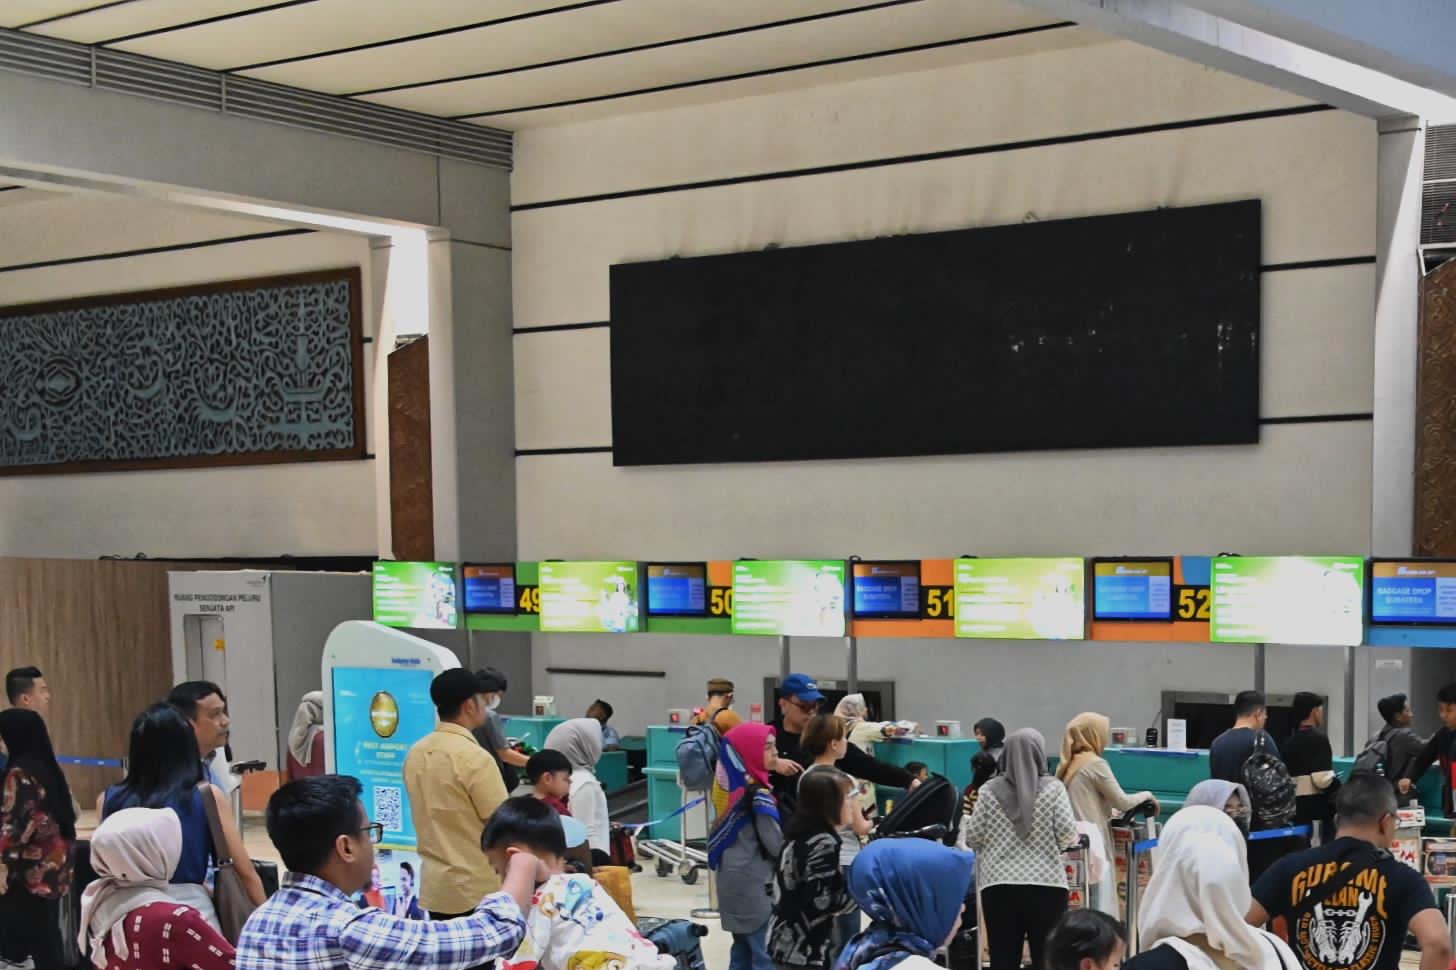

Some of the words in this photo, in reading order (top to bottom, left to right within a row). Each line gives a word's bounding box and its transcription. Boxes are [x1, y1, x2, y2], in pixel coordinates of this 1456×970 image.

[520, 588, 539, 612] 49
[711, 589, 732, 615] 50
[928, 589, 954, 616] 51
[1179, 589, 1211, 618] 52
